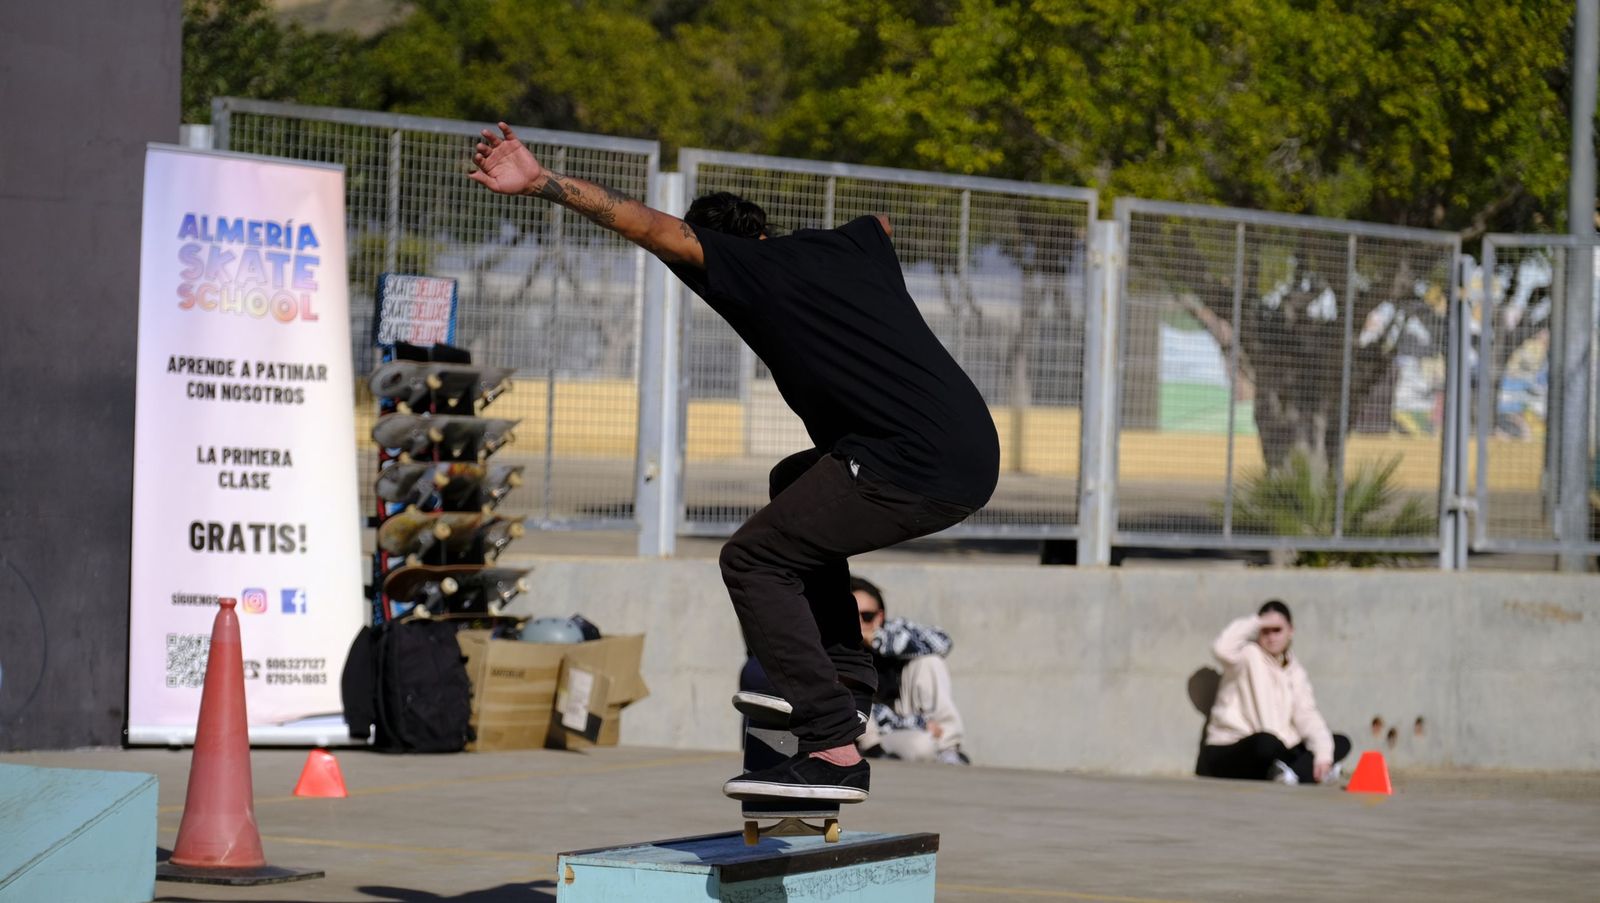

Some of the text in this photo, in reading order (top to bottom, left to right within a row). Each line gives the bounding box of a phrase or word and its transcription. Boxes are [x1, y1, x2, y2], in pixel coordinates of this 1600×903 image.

[178, 213, 320, 250] ALMERÍA
[177, 242, 320, 292] SKATE
[176, 283, 319, 324] SCHOOL
[167, 355, 328, 381] APRENDE A PATINAR
[187, 382, 305, 405] CON NOSOTROS
[197, 446, 293, 467] LA PRIMERA
[218, 471, 271, 490] CLASE
[189, 521, 307, 553] GRATIS!
